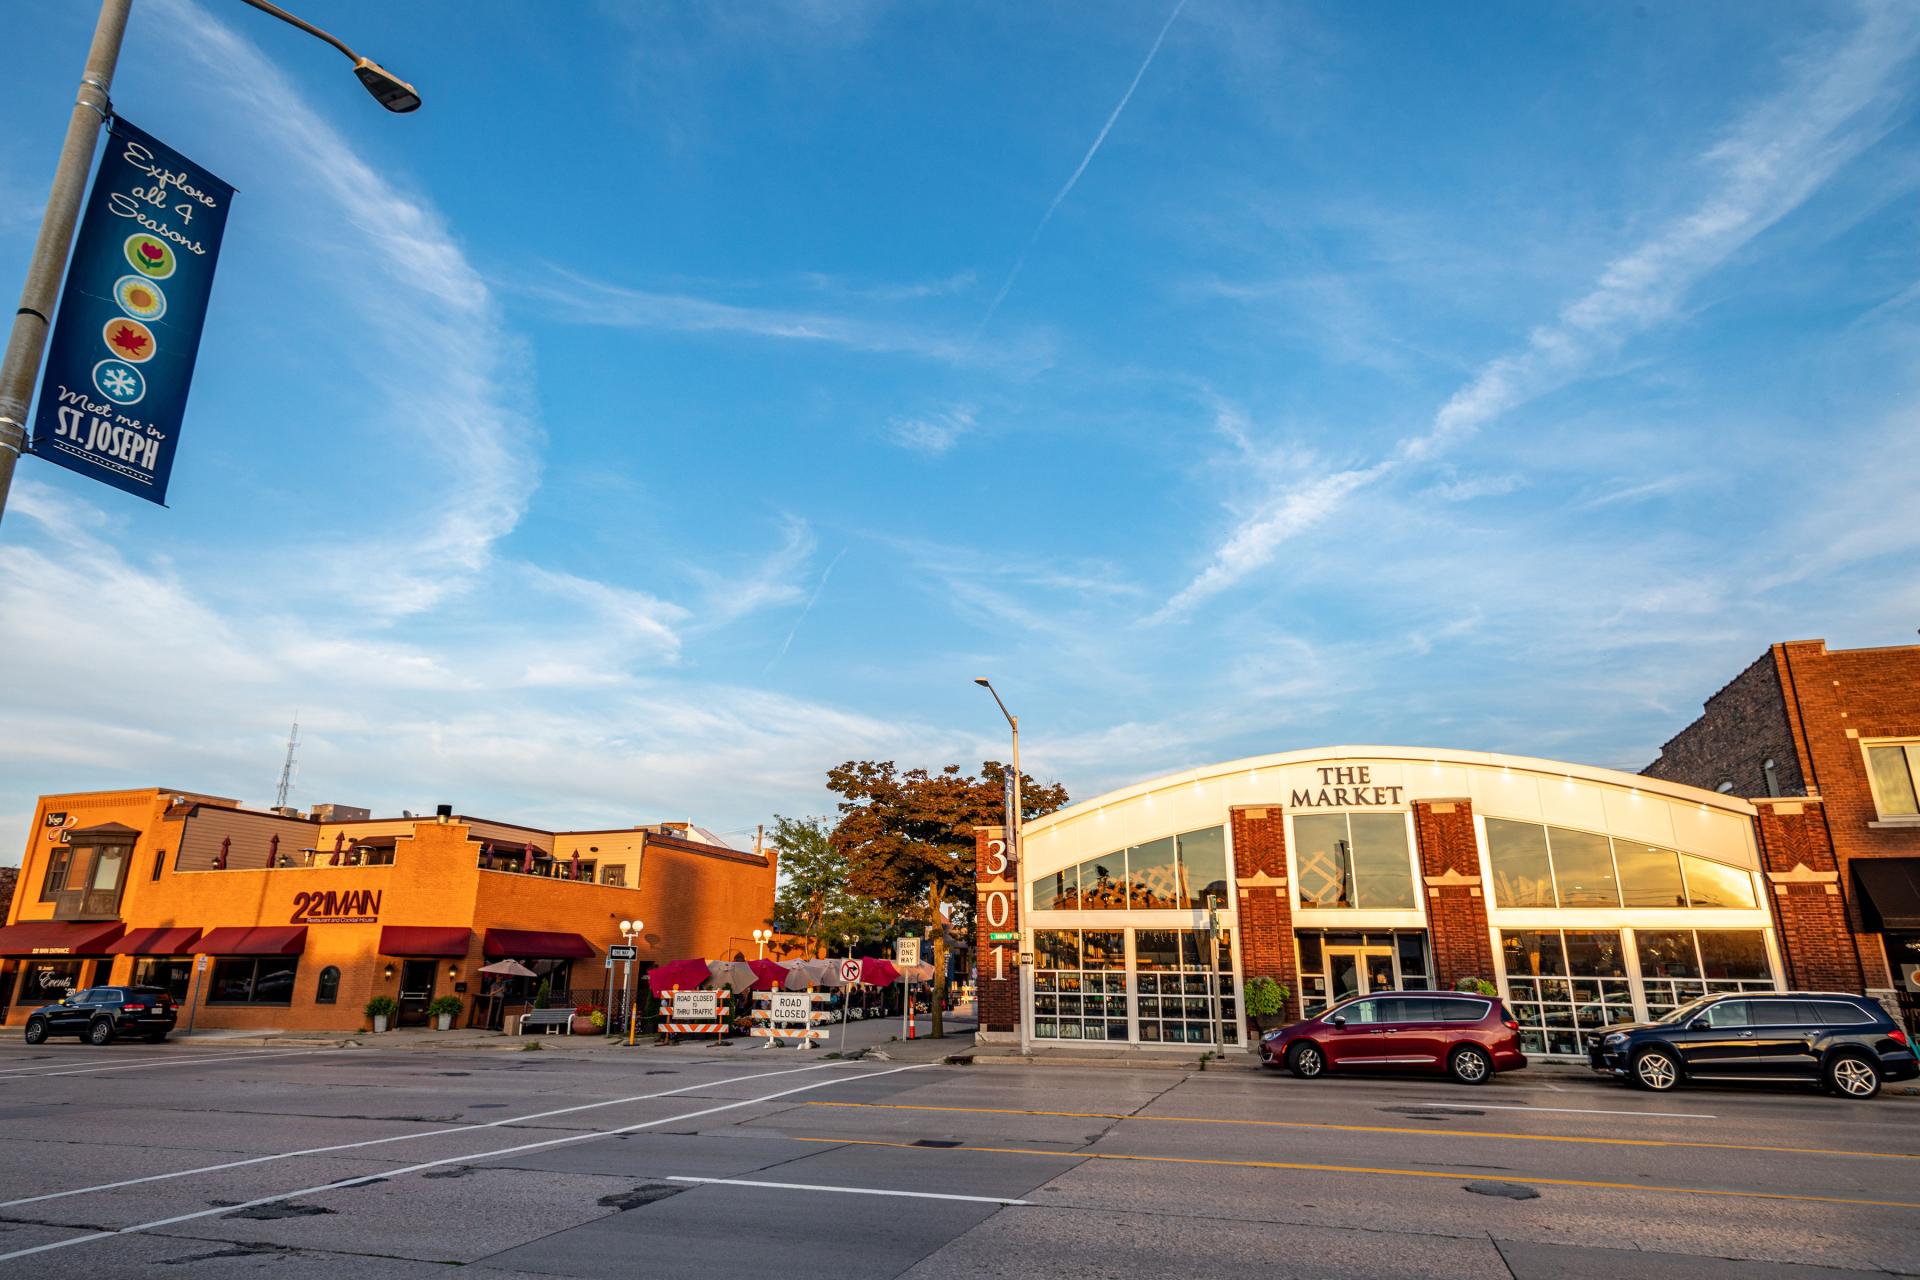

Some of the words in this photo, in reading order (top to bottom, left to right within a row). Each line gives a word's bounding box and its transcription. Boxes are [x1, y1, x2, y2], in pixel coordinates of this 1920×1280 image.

[123, 142, 217, 208] Explore
[108, 192, 206, 254] Seasons
[131, 186, 167, 209] all
[174, 204, 193, 225] 4
[58, 385, 113, 418] Meet
[115, 414, 142, 430] me
[146, 423, 166, 440] in
[54, 405, 84, 444] ST.
[84, 417, 160, 471] JOSEPH
[1316, 766, 1371, 786] THE
[1290, 786, 1403, 808] MARKET
[774, 1009, 807, 1019] CLOSED
[779, 998, 802, 1007] ROAD
